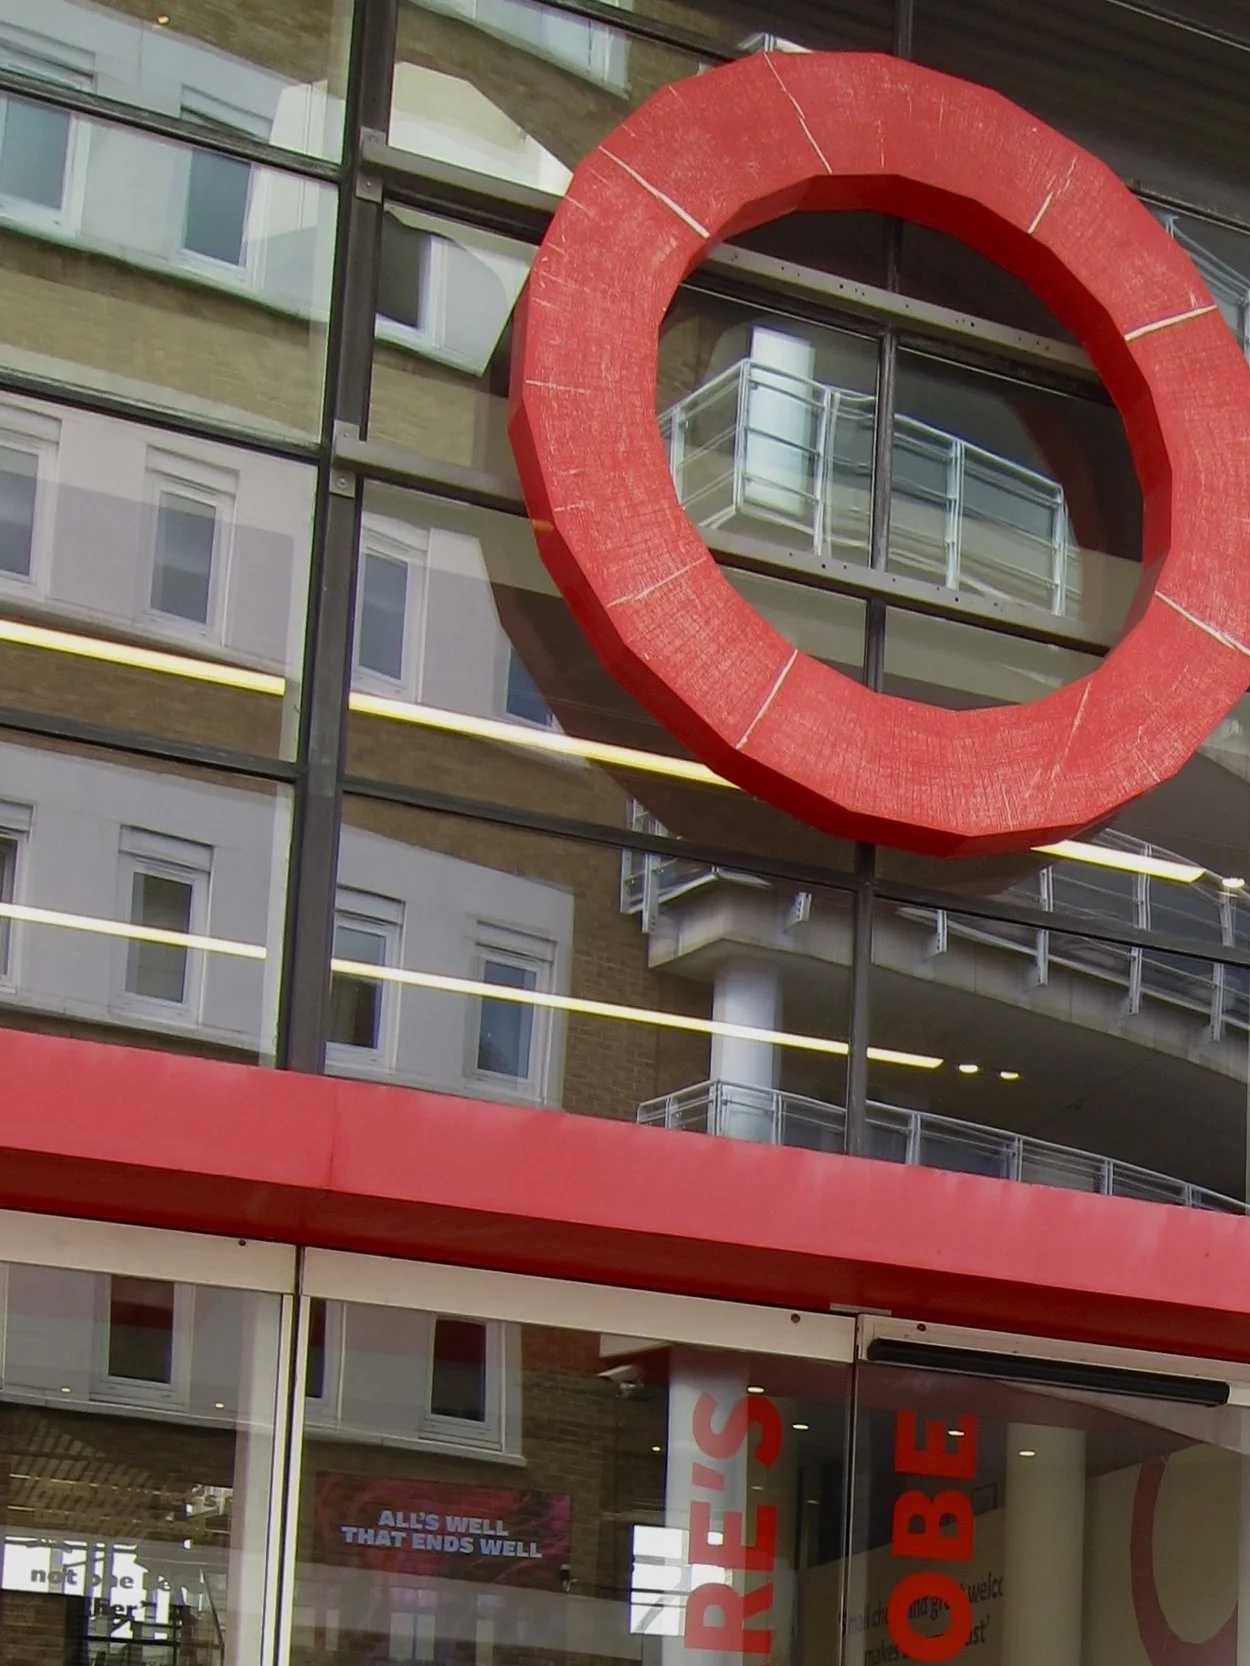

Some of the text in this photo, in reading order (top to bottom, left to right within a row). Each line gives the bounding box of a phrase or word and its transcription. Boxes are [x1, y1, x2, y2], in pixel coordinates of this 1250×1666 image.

[379, 1510, 509, 1537] ALL'S WELL
[341, 1526, 543, 1559] THAT ENDS WELL
